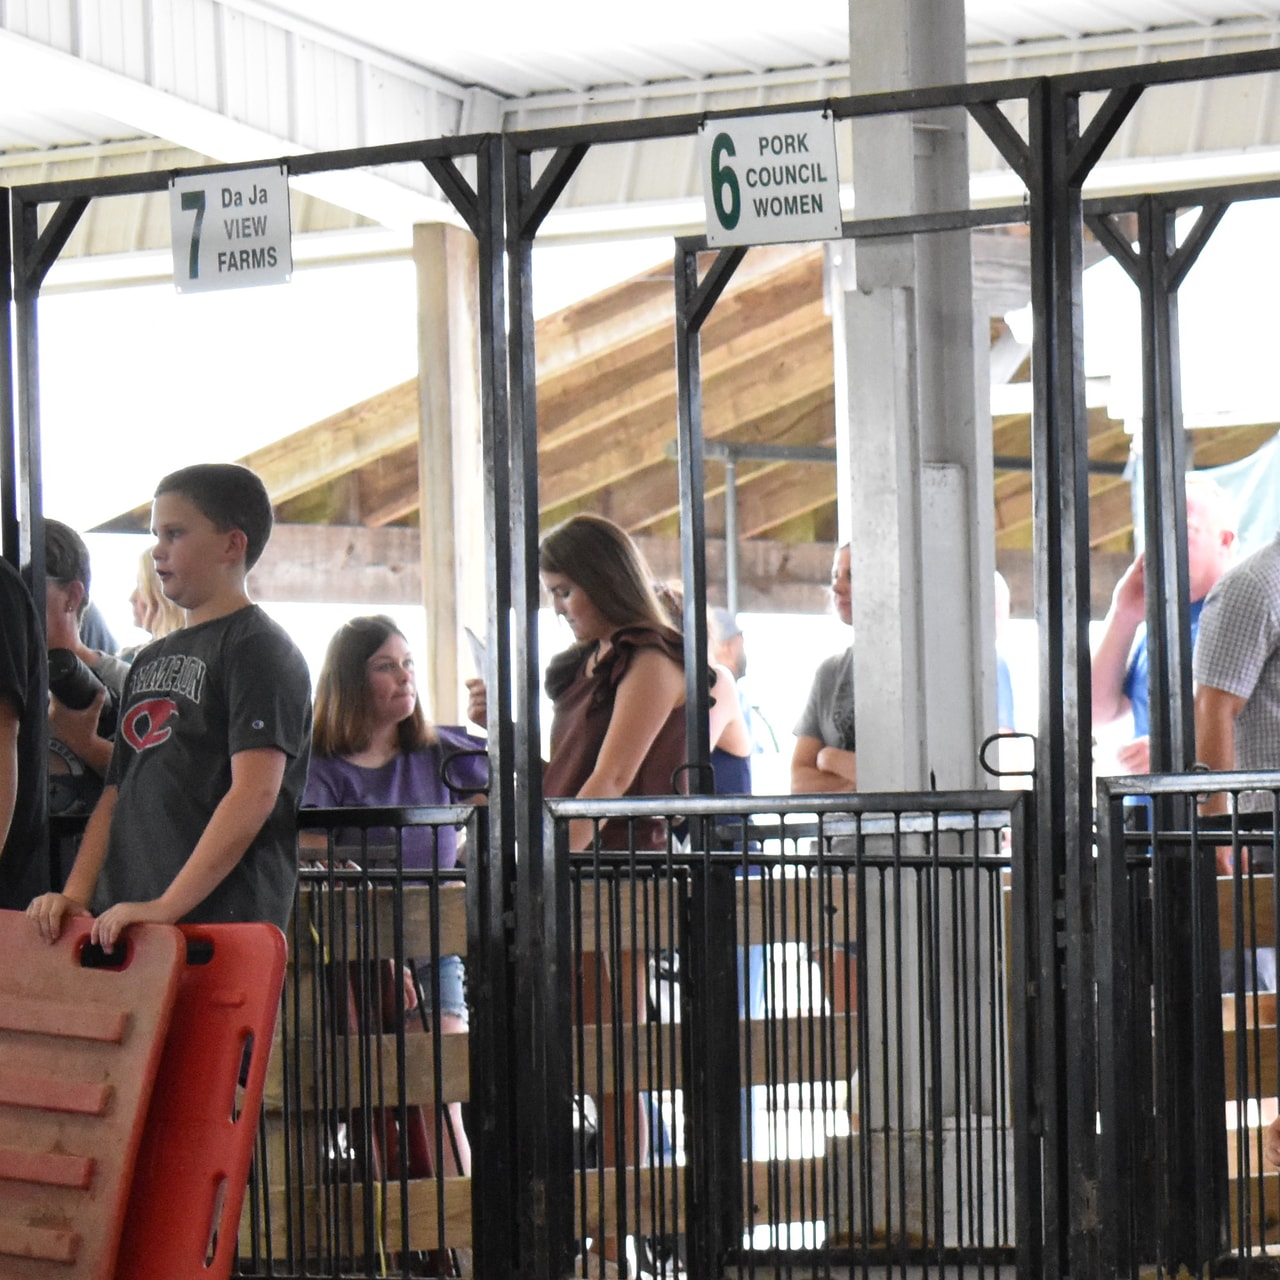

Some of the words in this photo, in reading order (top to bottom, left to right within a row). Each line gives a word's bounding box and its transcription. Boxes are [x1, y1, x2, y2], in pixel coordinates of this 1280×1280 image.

[758, 133, 809, 156] PORK
[711, 132, 741, 231] 6
[746, 163, 828, 188] COUNCIL
[221, 187, 243, 209] Da
[248, 184, 268, 205] Ja
[753, 193, 823, 218] WOMEN
[181, 190, 206, 279] 7
[223, 215, 268, 240] VIEW
[217, 246, 278, 273] FARMS
